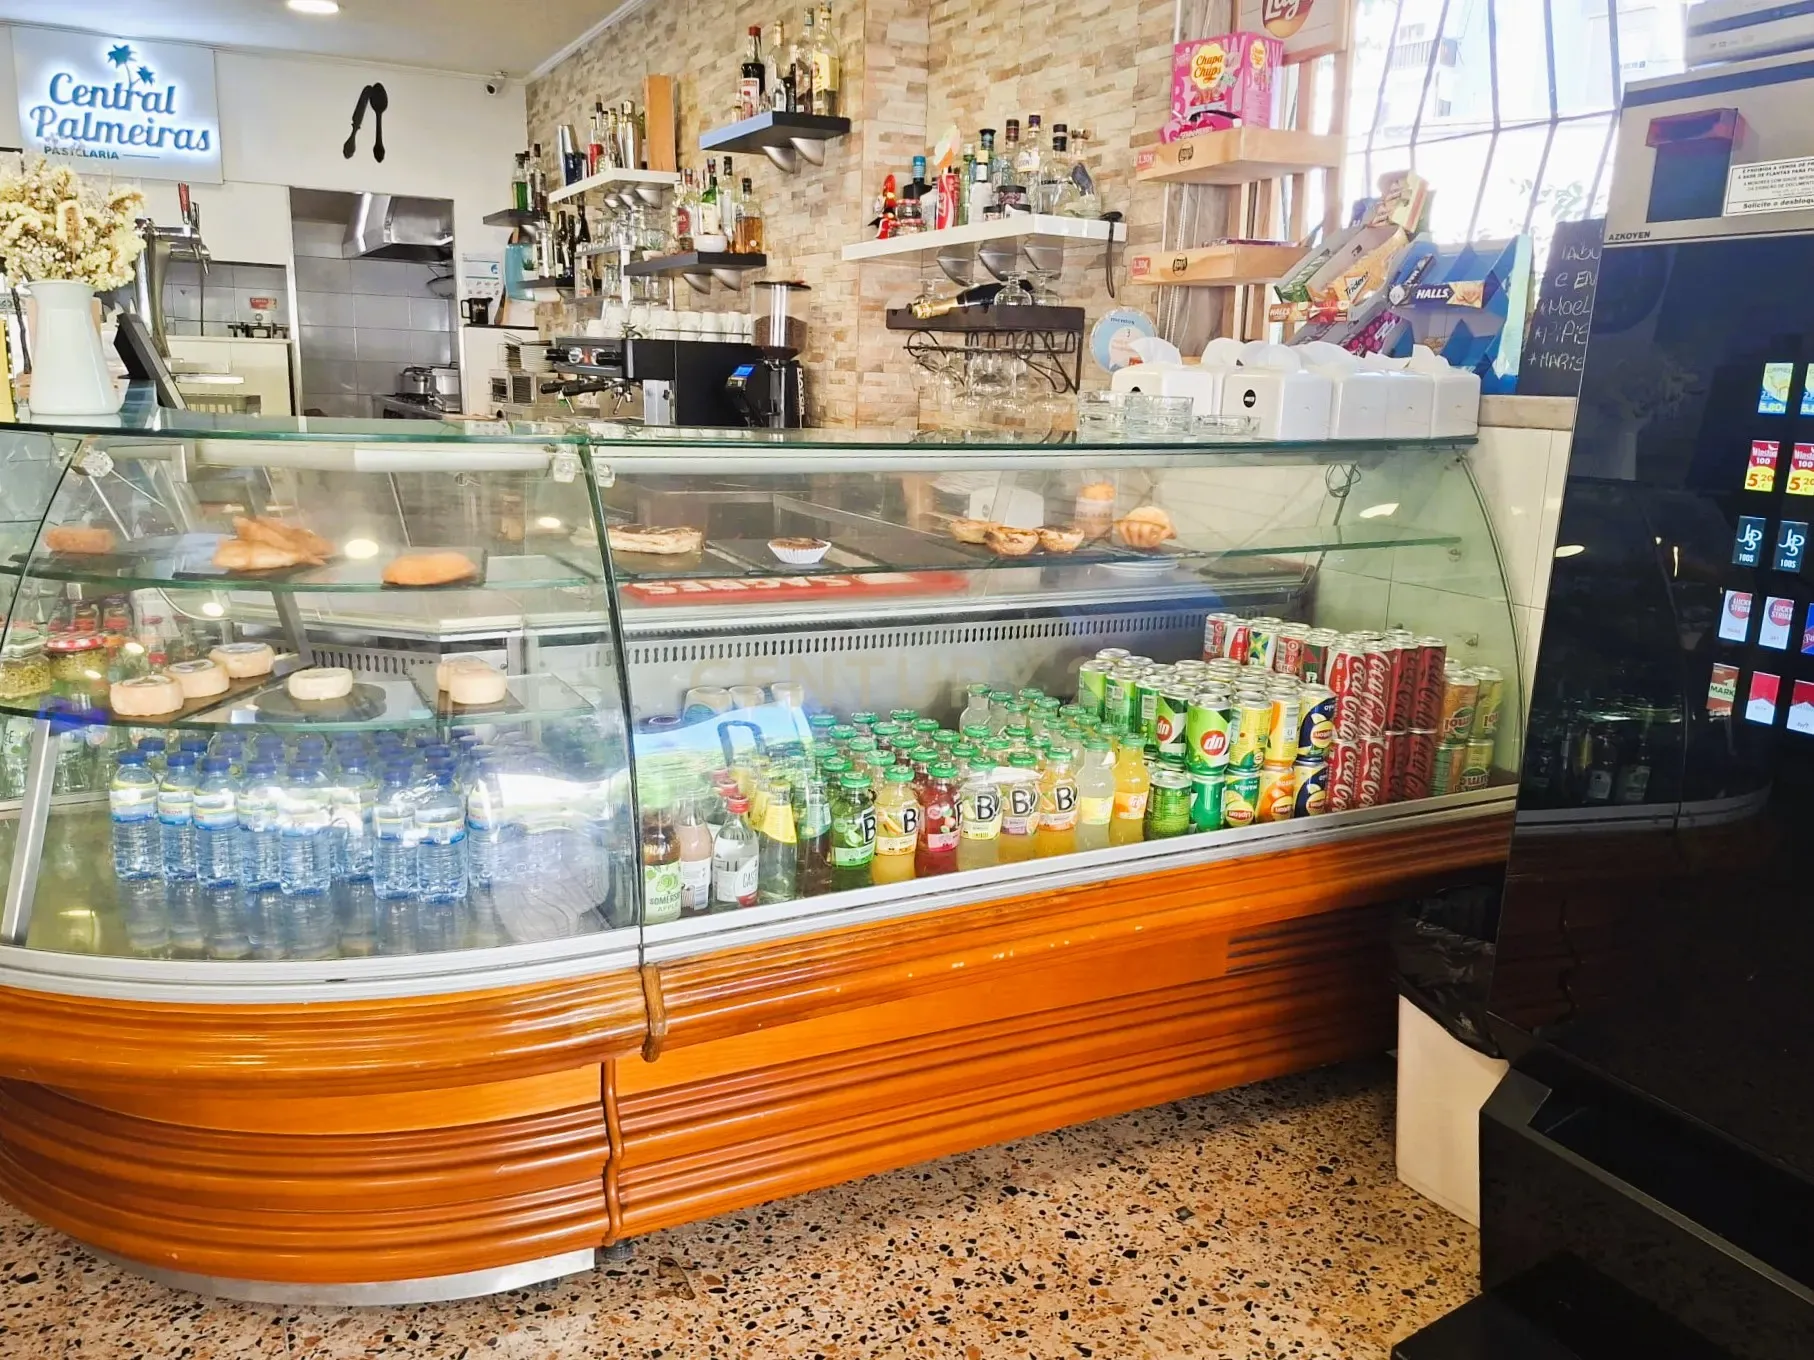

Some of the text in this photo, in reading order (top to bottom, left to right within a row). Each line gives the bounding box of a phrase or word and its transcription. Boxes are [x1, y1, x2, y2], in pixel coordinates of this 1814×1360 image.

[1196, 54, 1224, 67] Chupa
[1194, 66, 1222, 79] Chups
[49, 72, 176, 115] Central
[30, 105, 210, 151] Palmeiras
[1608, 231, 1650, 241] AZKOYEN
[1343, 271, 1370, 298] Trident
[1415, 288, 1450, 300] HALLS
[1756, 457, 1771, 465] 100
[1798, 460, 1813, 468] 100
[1205, 736, 1225, 752] up
[1011, 789, 1037, 815] B!
[1228, 811, 1253, 820] Lipton
